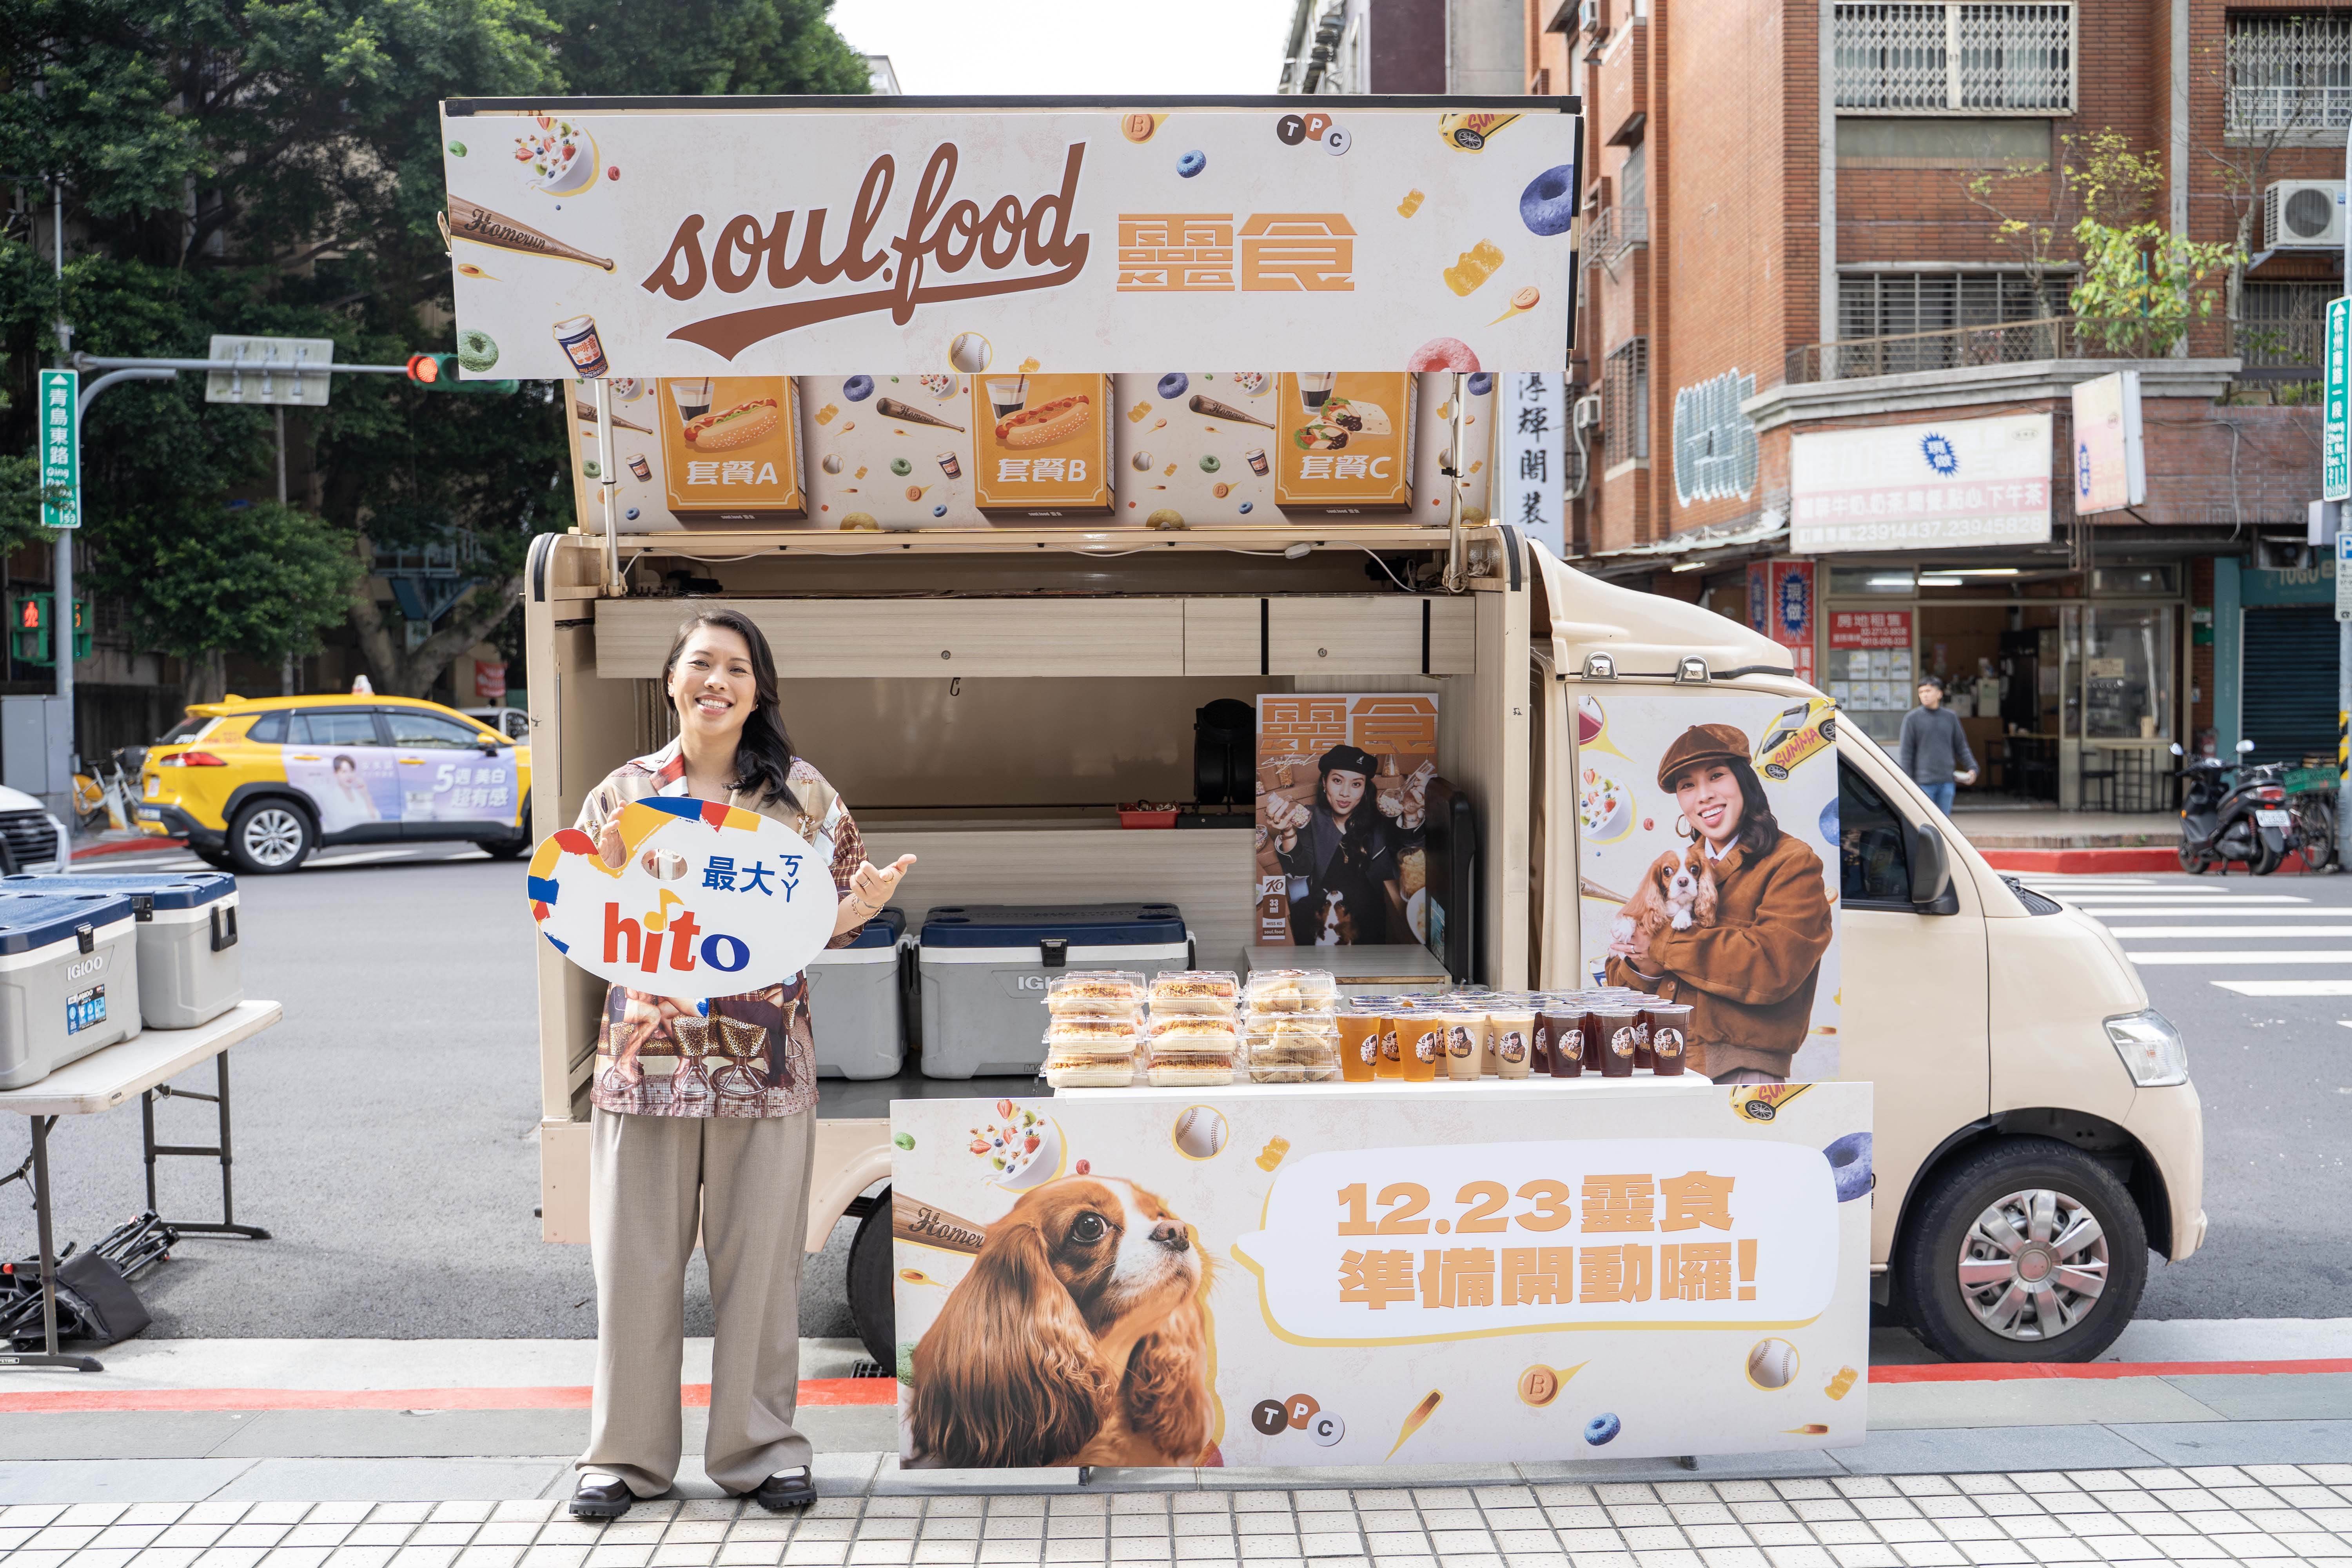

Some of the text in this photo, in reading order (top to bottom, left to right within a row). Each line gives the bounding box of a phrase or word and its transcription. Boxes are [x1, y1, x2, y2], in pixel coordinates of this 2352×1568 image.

[464, 209, 545, 250] Homerun
[642, 142, 1090, 326] soul.food
[1117, 213, 1357, 291] 靈食
[49, 388, 69, 465] 青島東路
[897, 405, 934, 423] Homerun
[1210, 403, 1245, 420] Homerun
[46, 466, 69, 479] Qing
[686, 461, 778, 485] 套餐A
[997, 458, 1086, 482] 套餐B
[1300, 455, 1391, 479] 套餐C
[1926, 440, 1953, 468] 現做
[1260, 697, 1438, 754] 靈食
[1775, 728, 1821, 767] SUMMA
[604, 889, 750, 974] hito
[67, 956, 103, 981] IGLOO
[1337, 1171, 1735, 1236] 12.23靈食
[909, 1206, 984, 1247] Homer
[1339, 1239, 1758, 1309] 準備開動囉!
